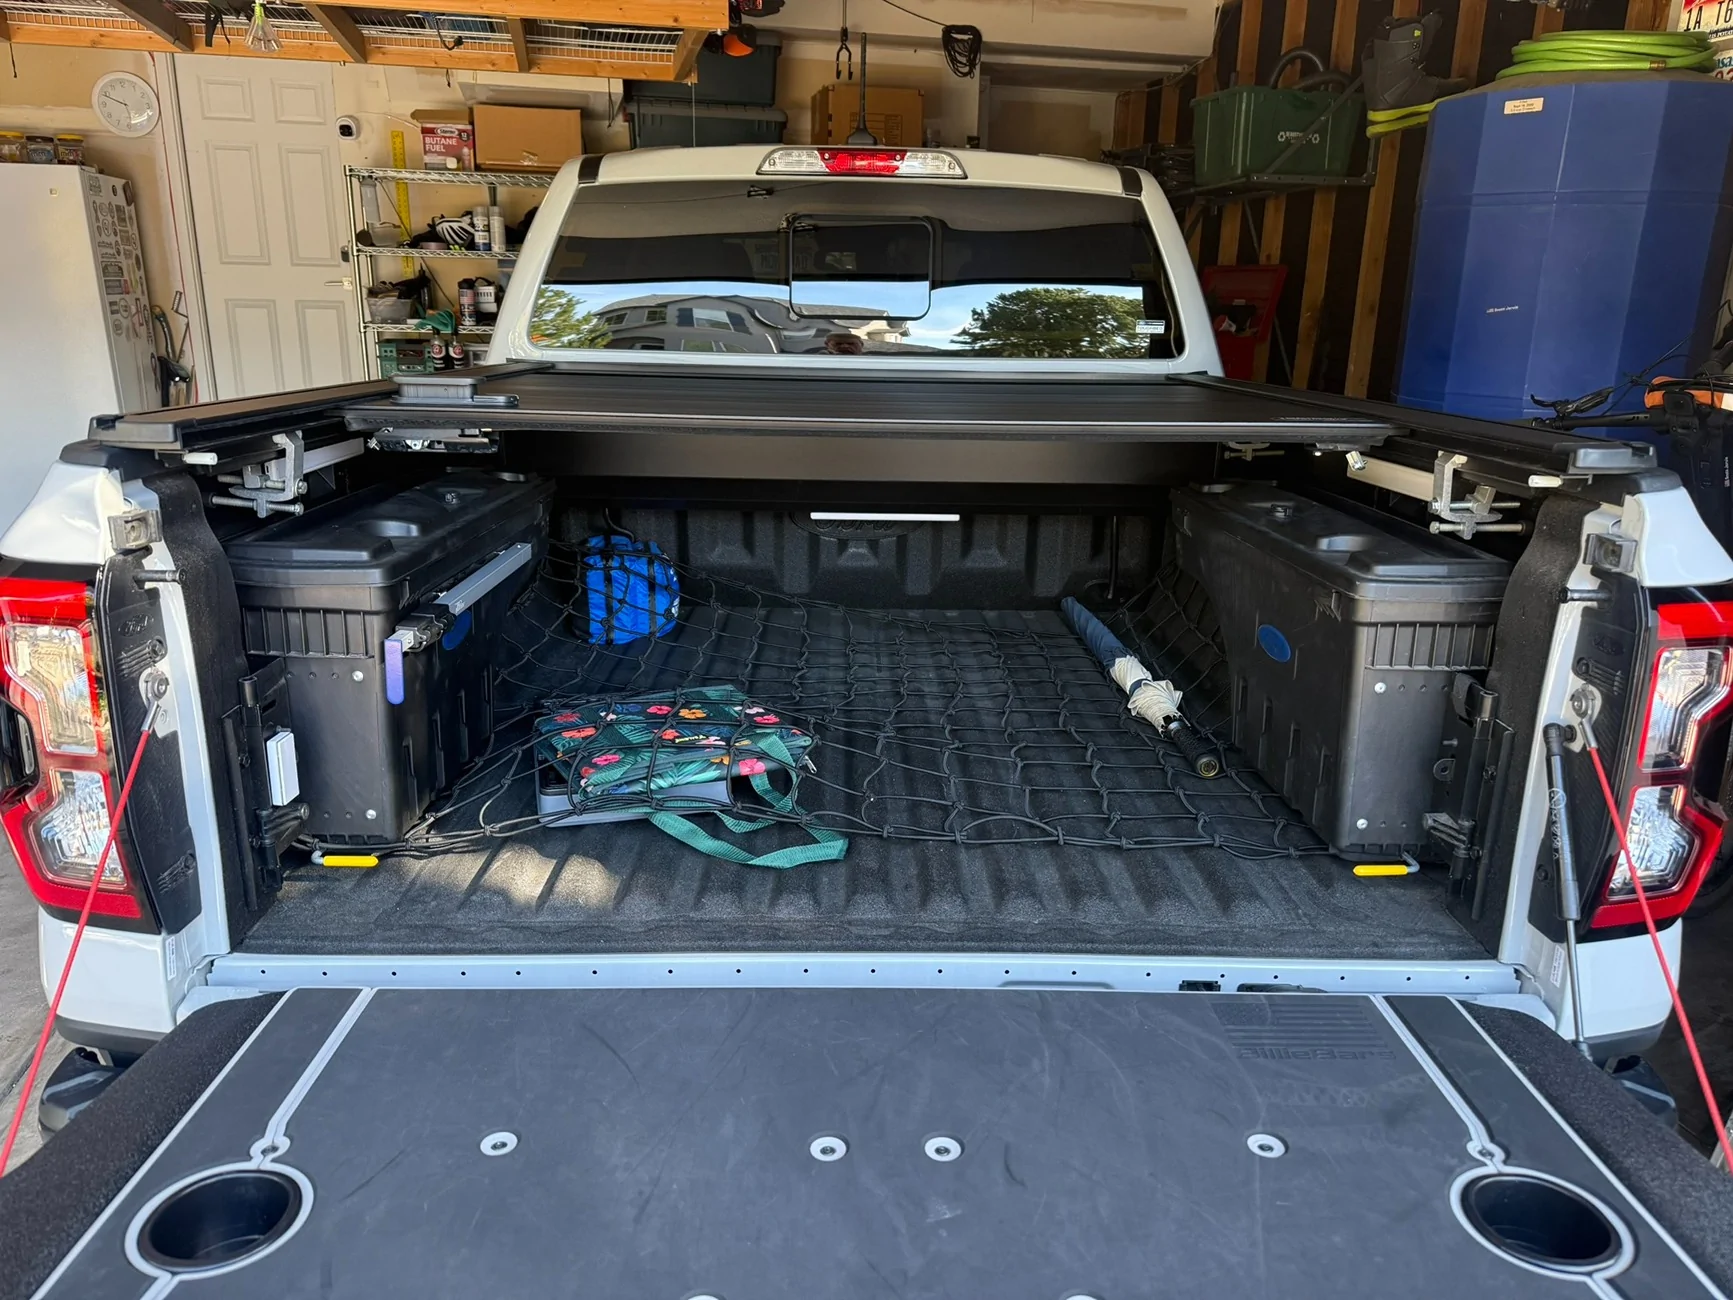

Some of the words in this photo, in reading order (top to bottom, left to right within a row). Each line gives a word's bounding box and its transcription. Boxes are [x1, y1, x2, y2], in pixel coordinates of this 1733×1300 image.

[1684, 5, 1703, 32] 1A
[425, 137, 458, 145] BUTANE
[425, 144, 446, 152] FUEL
